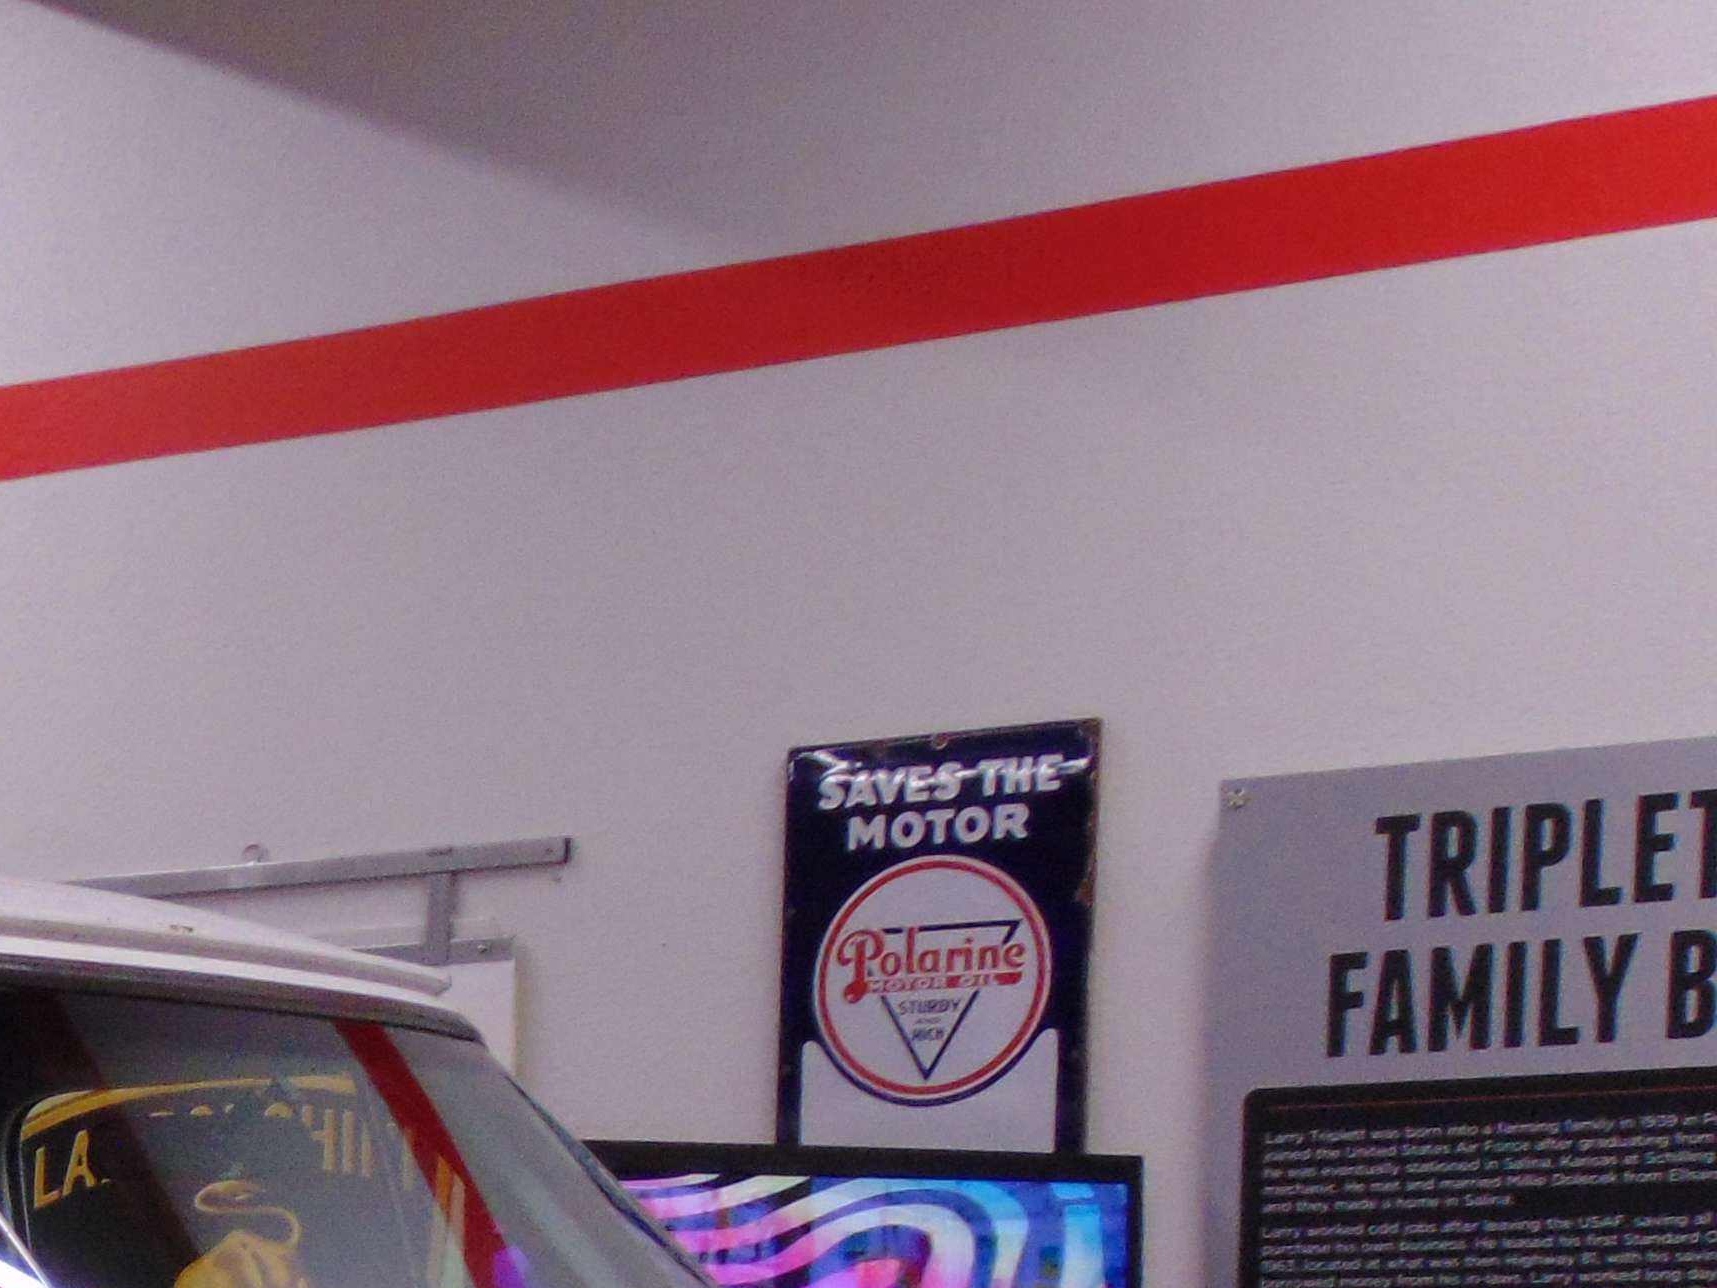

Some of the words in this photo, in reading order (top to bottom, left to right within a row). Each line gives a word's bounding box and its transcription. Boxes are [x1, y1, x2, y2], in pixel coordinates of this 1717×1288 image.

[818, 761, 963, 810] SAVES
[976, 754, 1064, 797] THE
[845, 802, 1031, 851] MOTOR
[836, 927, 1026, 1003] Polarine
[869, 976, 948, 991] MOTOR
[958, 974, 991, 988] OIL
[1326, 933, 1642, 1058] FAMILY
